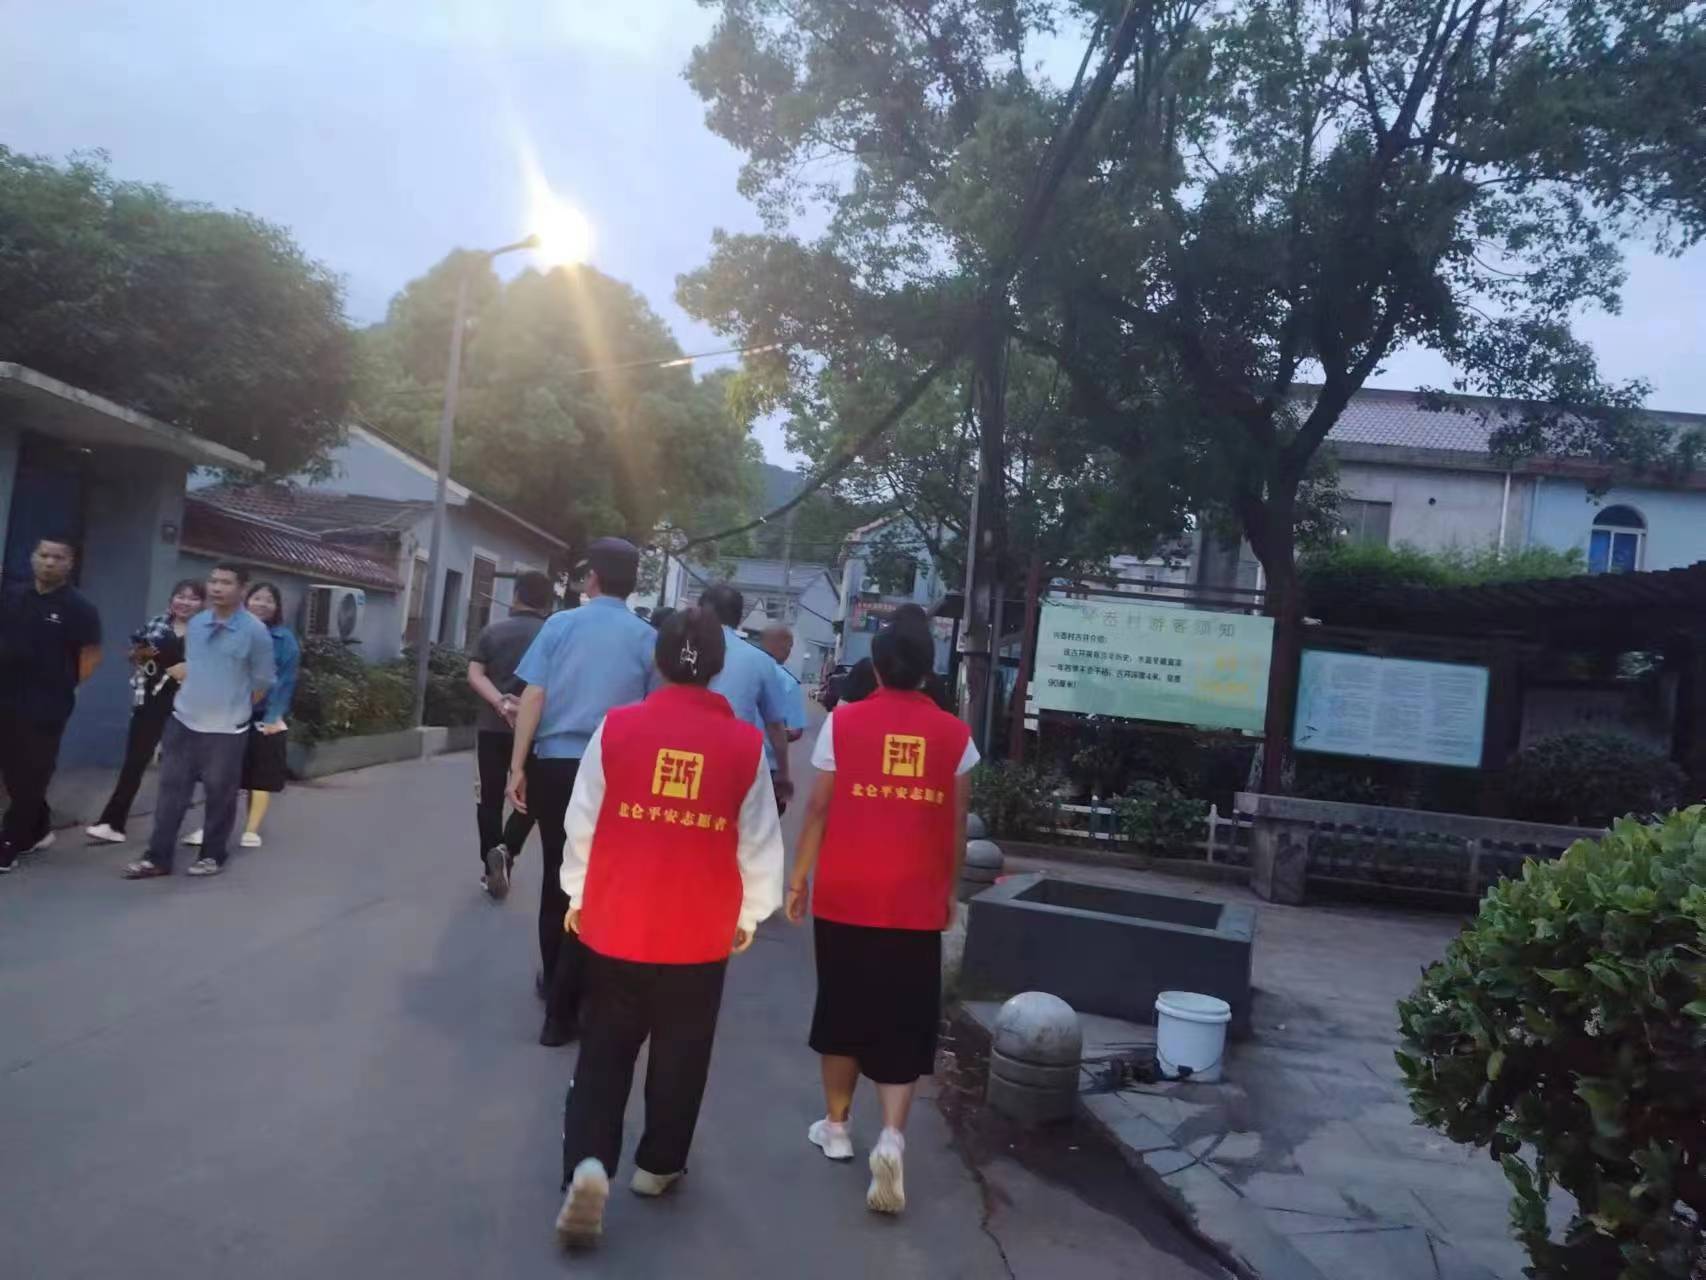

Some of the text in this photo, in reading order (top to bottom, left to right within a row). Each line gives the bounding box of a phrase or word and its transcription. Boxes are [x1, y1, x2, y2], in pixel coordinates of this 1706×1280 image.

[618, 801, 728, 832] 北仑平安志愿者
